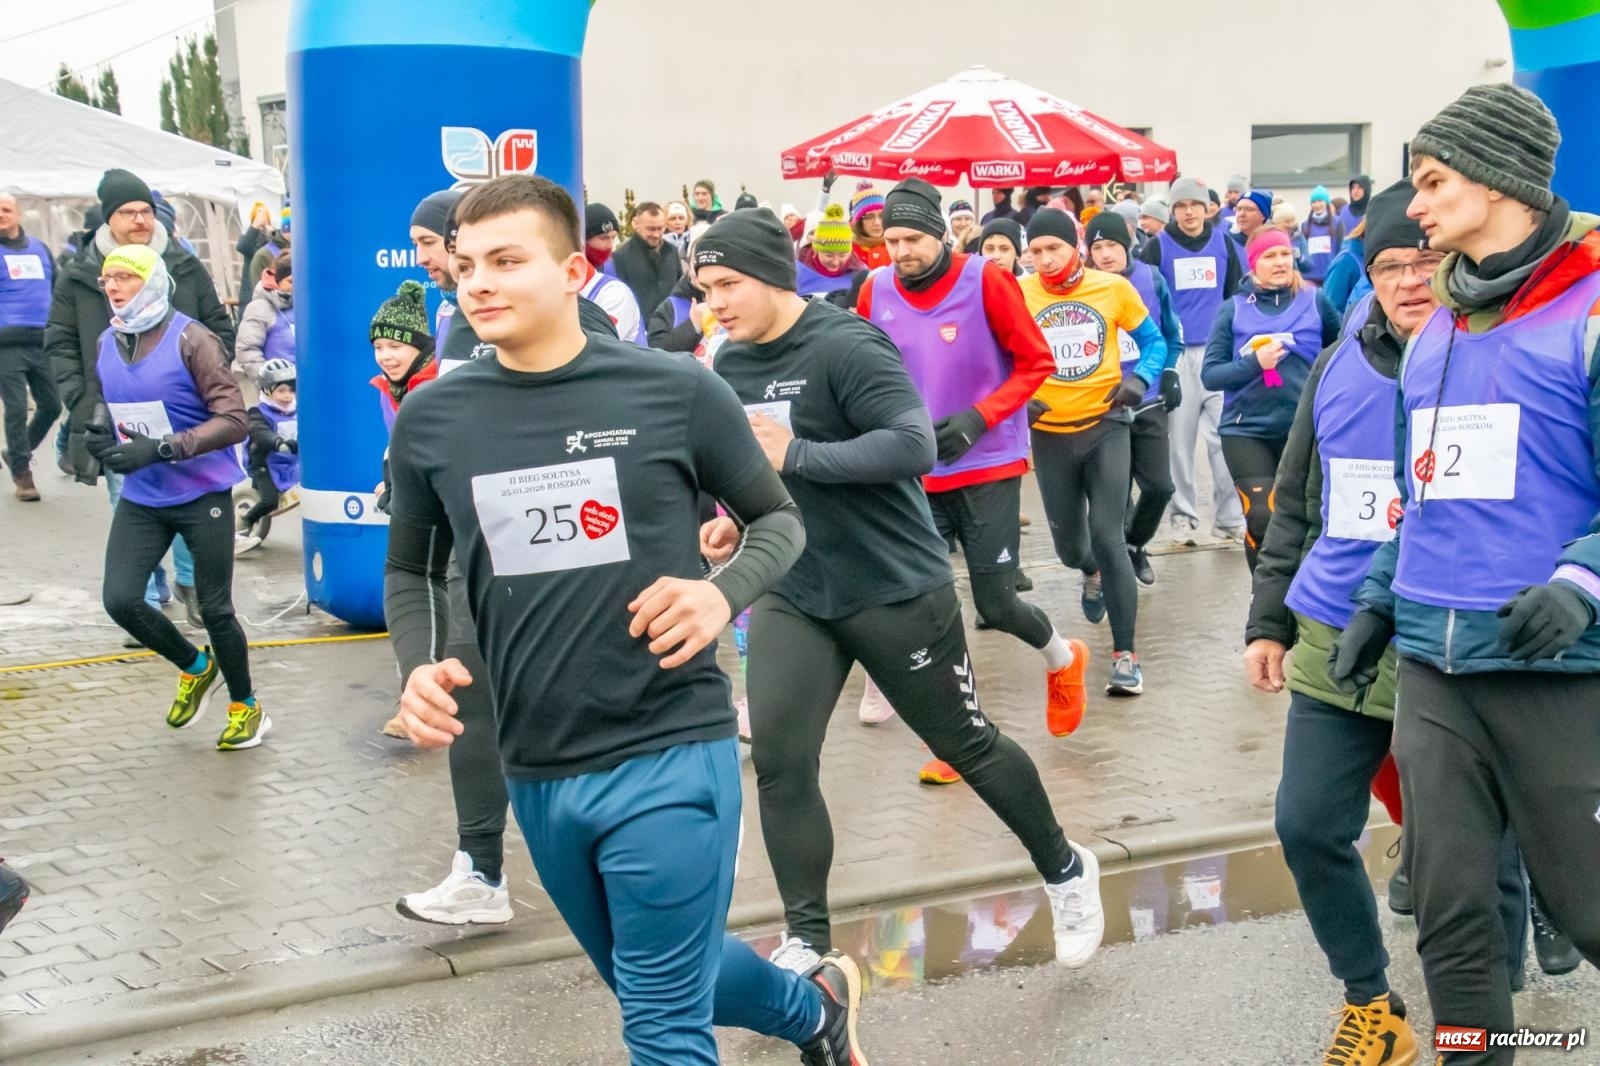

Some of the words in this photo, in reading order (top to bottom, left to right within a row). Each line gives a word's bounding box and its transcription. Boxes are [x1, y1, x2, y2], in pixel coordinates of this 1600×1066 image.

[888, 102, 951, 148] WARKA
[992, 101, 1043, 149] WARKA
[899, 158, 943, 175] Classic
[975, 165, 1021, 177] WARKA
[1054, 160, 1098, 178] Classic
[376, 248, 416, 268] GMI
[1189, 269, 1204, 281] 35
[1052, 342, 1083, 360] 102
[1443, 444, 1462, 477] 2
[508, 476, 517, 485] II
[518, 474, 540, 484] BIEG
[501, 484, 546, 497] 25.01.2026
[1358, 490, 1377, 520] 3
[526, 503, 578, 545] 25
